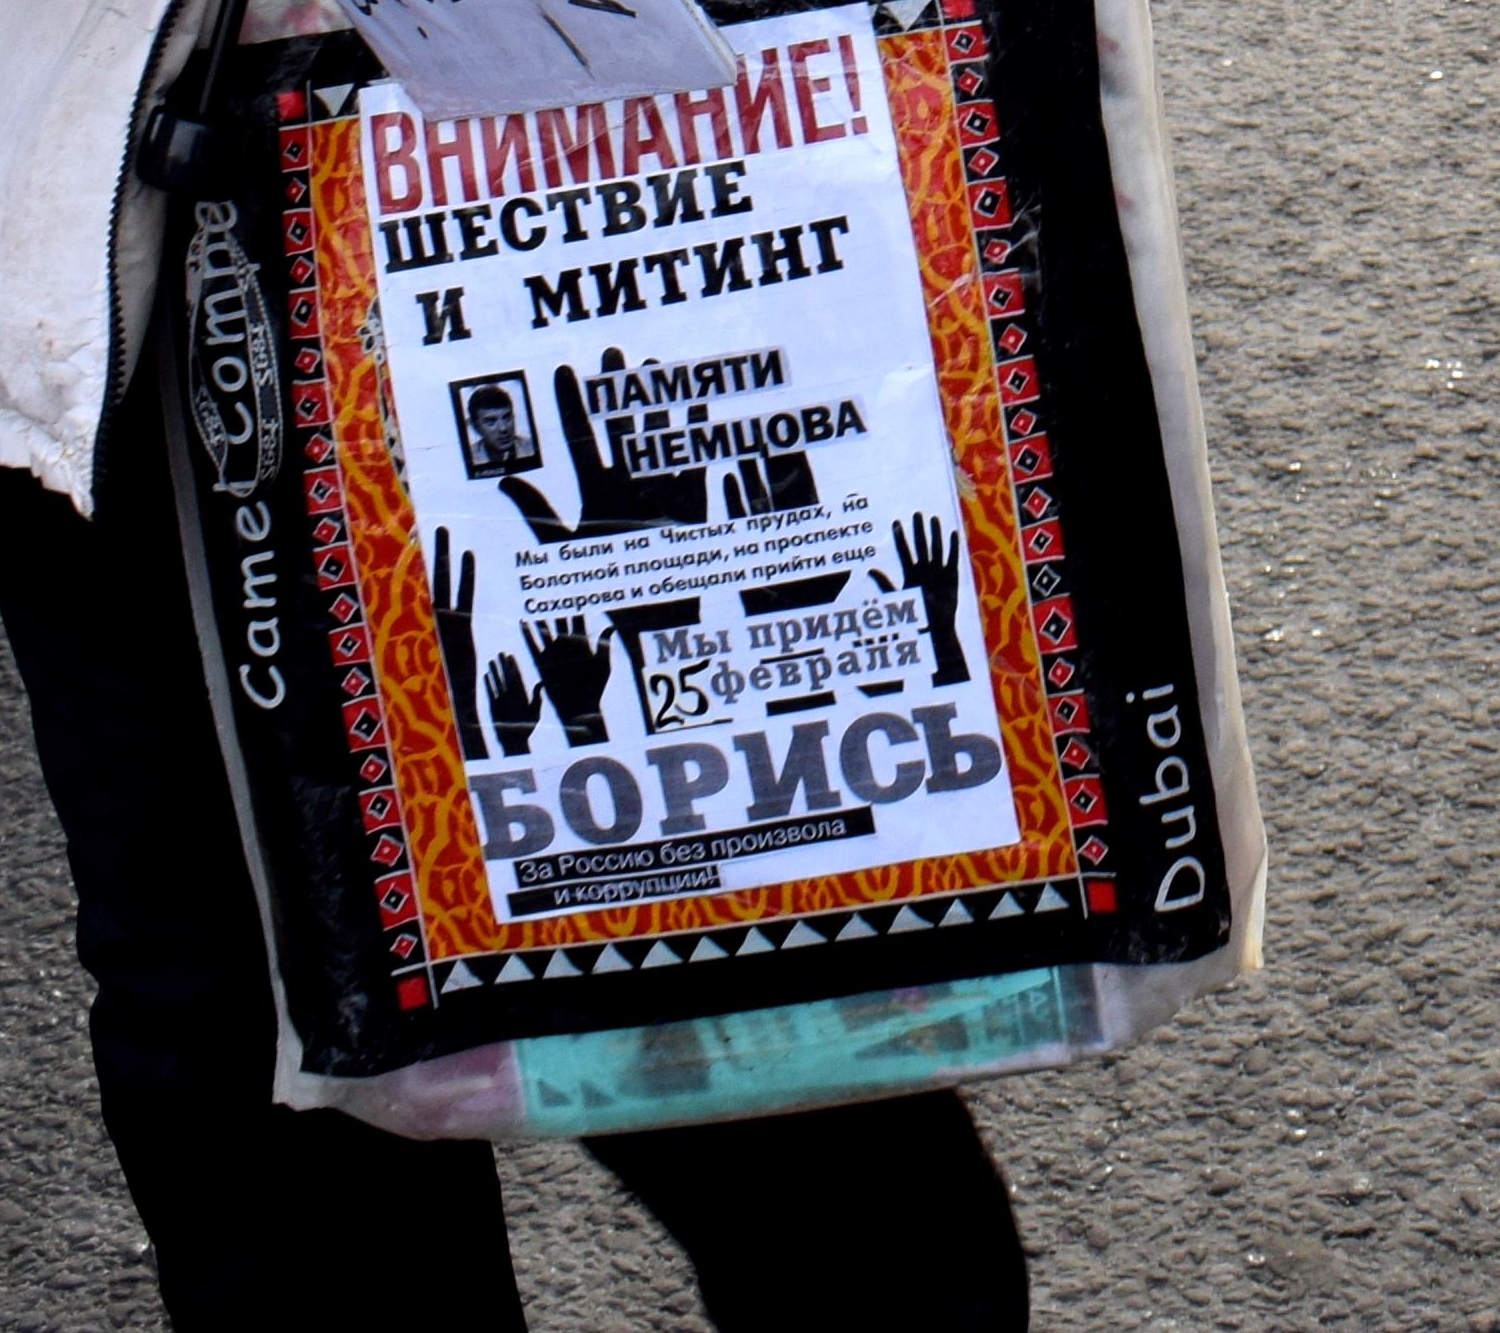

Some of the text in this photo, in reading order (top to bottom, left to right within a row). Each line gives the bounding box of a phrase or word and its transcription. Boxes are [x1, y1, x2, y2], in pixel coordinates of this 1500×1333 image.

[370, 34, 869, 215] ВНИМАНИЕ!
[378, 159, 754, 274] ШЕСТВИЕ
[415, 214, 850, 346] И МИТИНГ
[586, 349, 785, 415] ПАМЯТИ
[626, 398, 869, 474] НЕМЦОВА
[515, 549, 549, 568] Мы
[558, 541, 614, 562] были
[624, 534, 650, 552] на
[659, 520, 736, 545] Чистых
[746, 503, 832, 534] прудах,
[519, 518, 874, 592] Болотной площади, на проспекте
[523, 543, 878, 616] Сахарова и обещали прийти еще
[653, 597, 919, 665] Мы придём
[650, 637, 922, 729] 25 февраля
[468, 701, 1003, 862] БОРИСЬ
[1125, 683, 1206, 913] Dubai
[519, 816, 847, 884] За Россию без произвола
[553, 888, 571, 906] и
